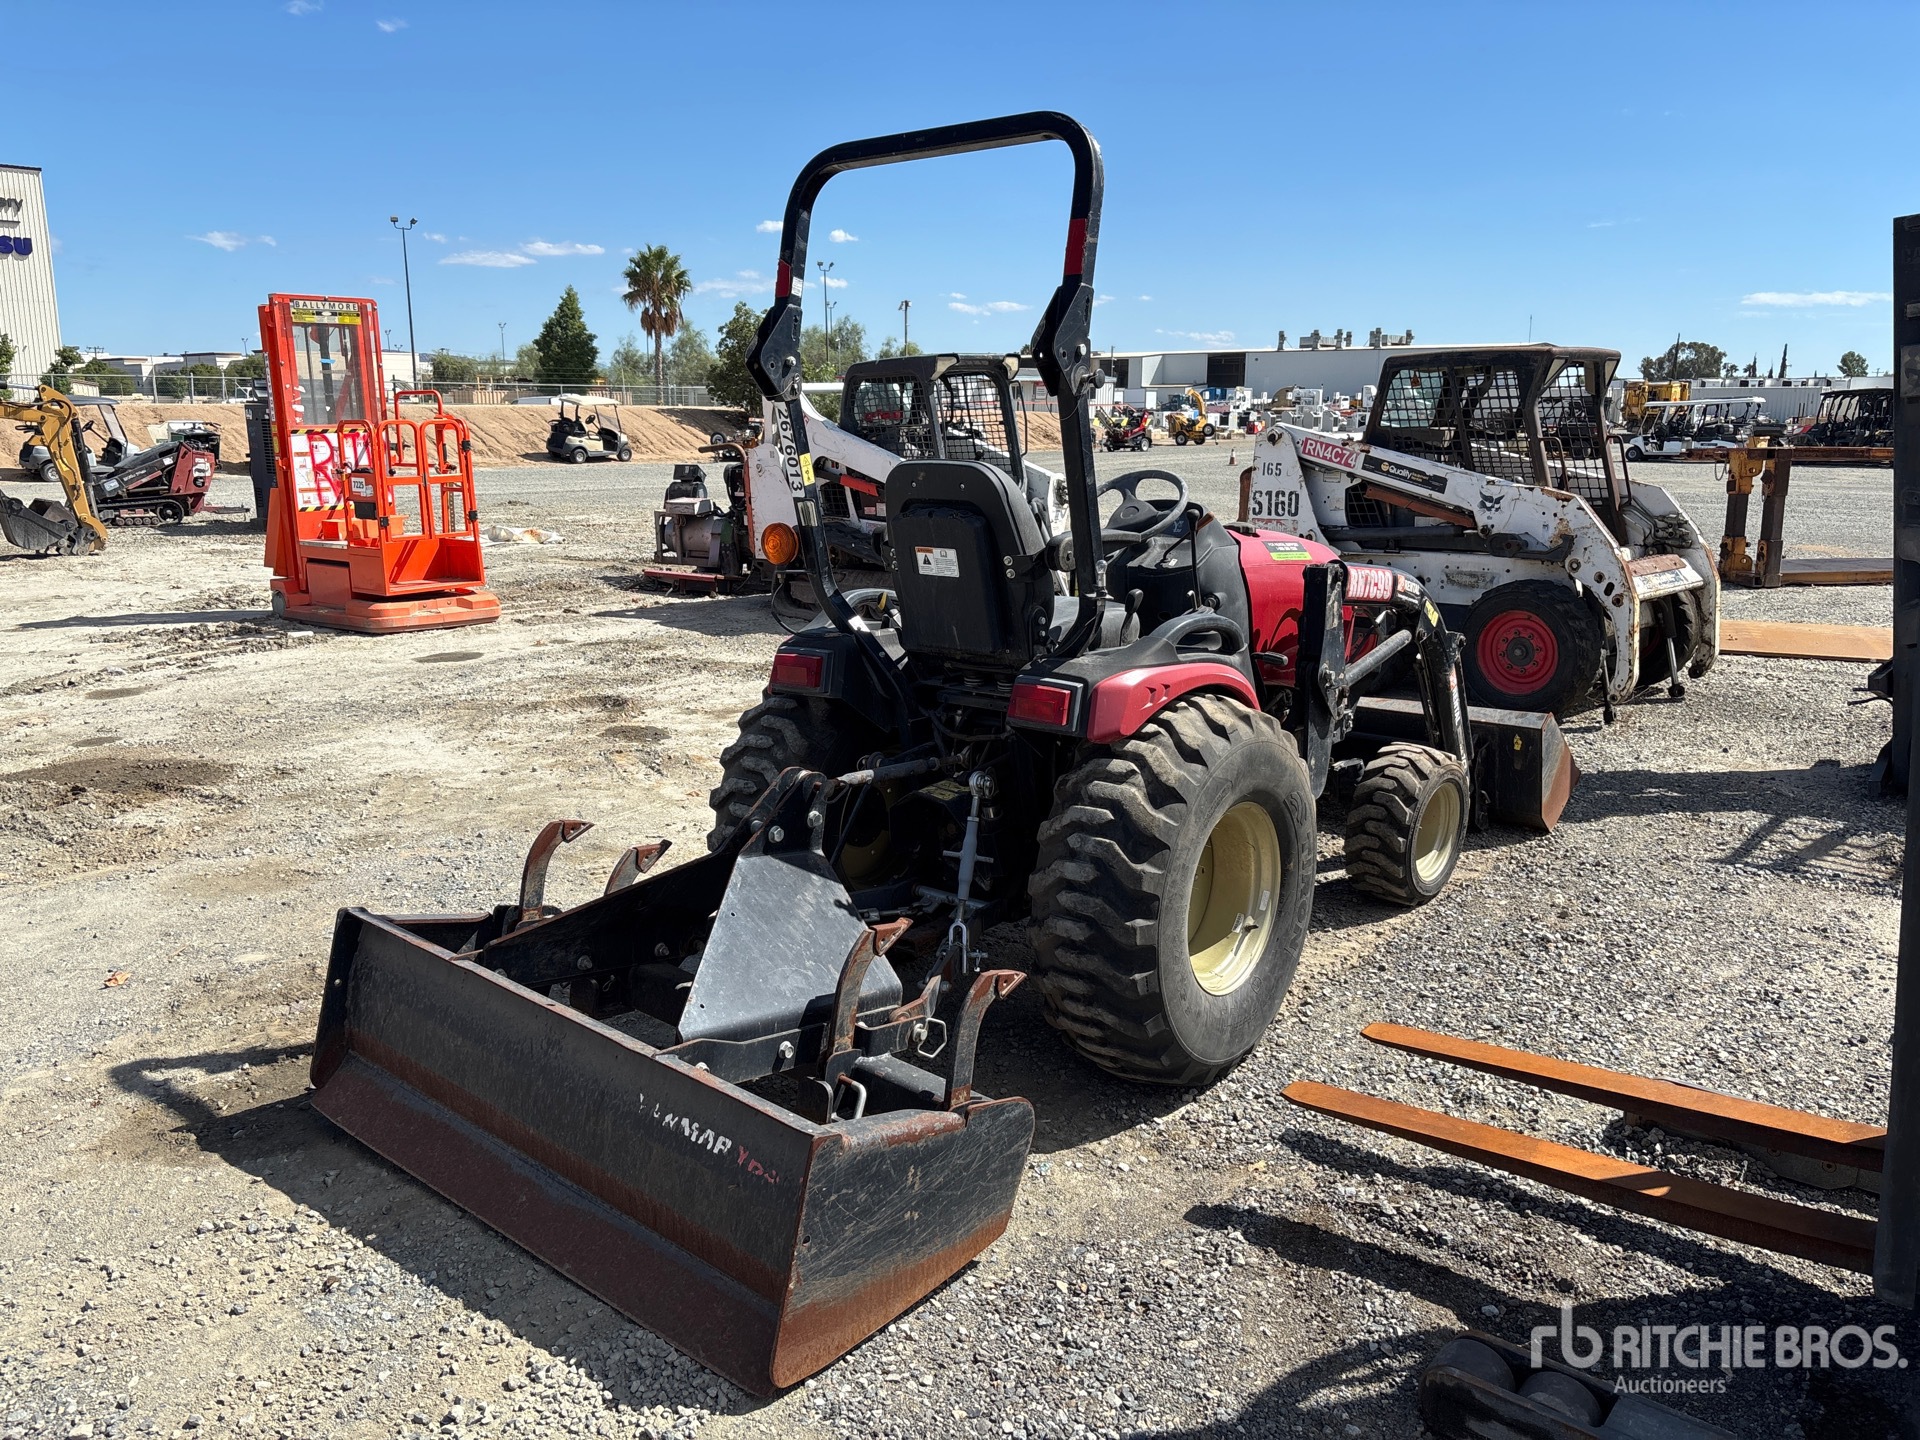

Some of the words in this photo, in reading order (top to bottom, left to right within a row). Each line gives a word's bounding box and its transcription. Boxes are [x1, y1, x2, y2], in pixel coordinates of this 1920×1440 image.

[295, 300, 358, 311] BALLYMORE
[779, 408, 803, 492] 2676013
[1304, 440, 1357, 468] RN4C74
[1262, 461, 1283, 477] 165
[1388, 464, 1413, 480] Quality
[352, 480, 365, 489] 7225
[1252, 489, 1300, 518] S160
